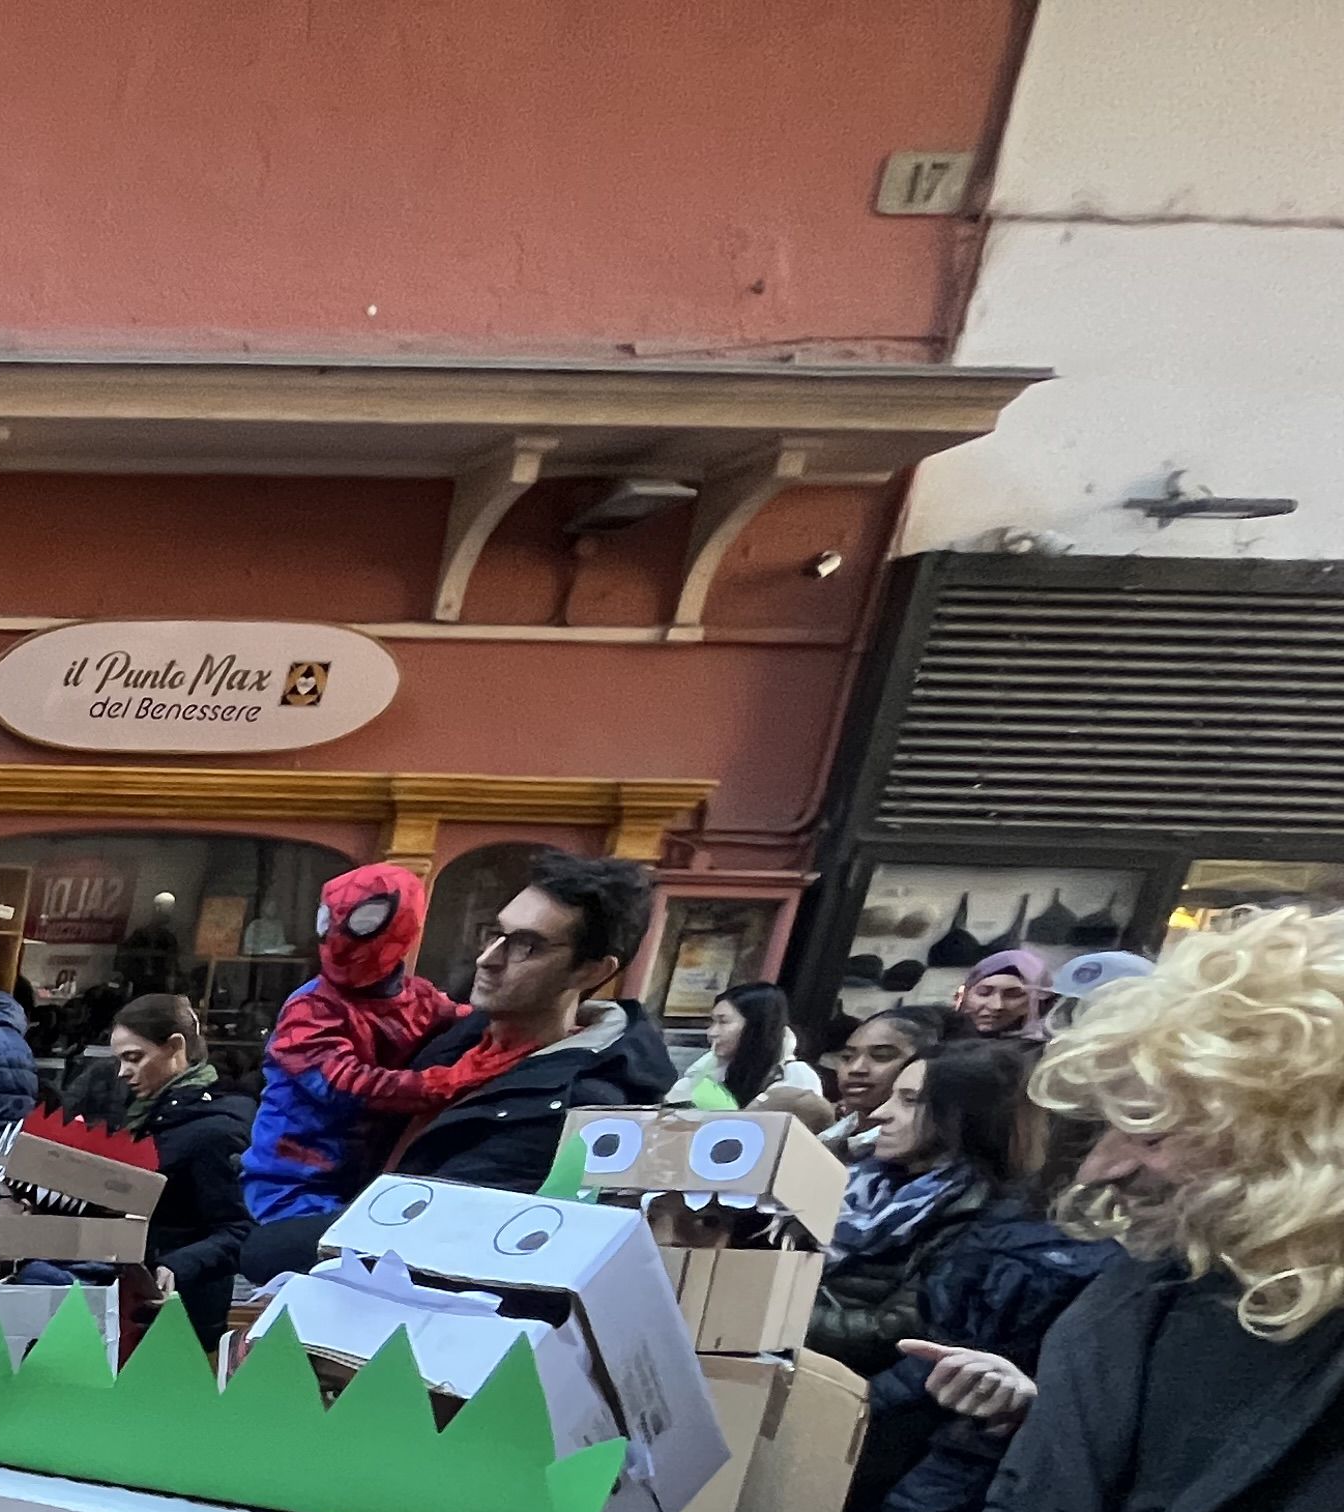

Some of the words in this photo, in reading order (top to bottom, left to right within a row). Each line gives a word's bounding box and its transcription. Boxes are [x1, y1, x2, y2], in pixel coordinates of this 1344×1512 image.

[903, 162, 951, 204] 17
[63, 656, 89, 687] il
[94, 650, 187, 694] Punto
[187, 653, 272, 697] Max
[89, 696, 133, 719] del
[135, 697, 263, 723] Benessere
